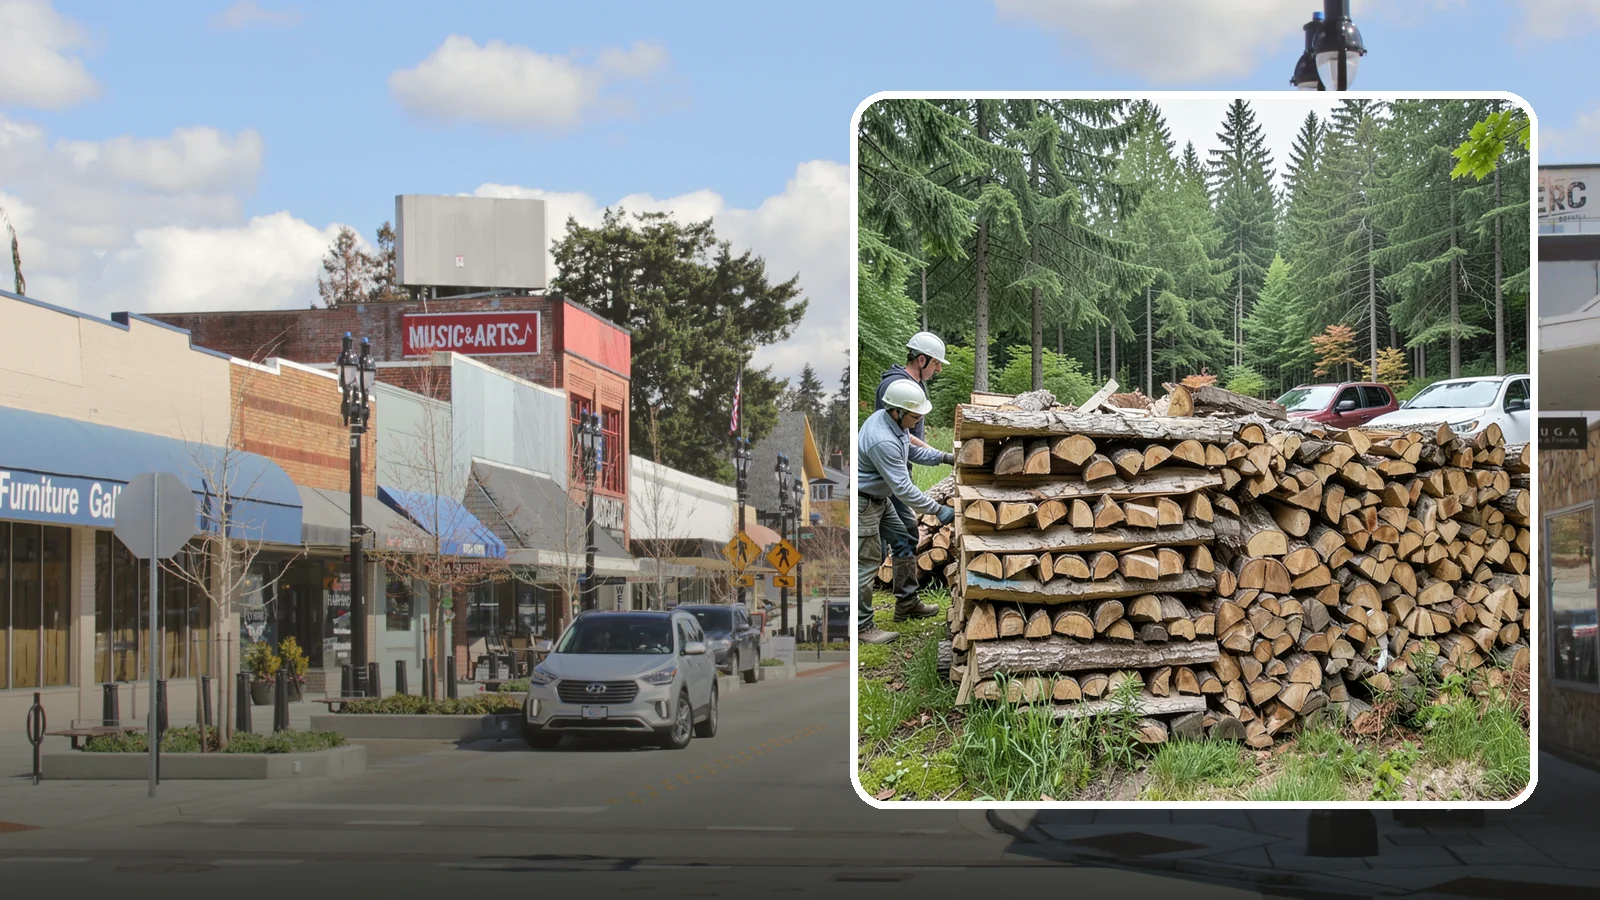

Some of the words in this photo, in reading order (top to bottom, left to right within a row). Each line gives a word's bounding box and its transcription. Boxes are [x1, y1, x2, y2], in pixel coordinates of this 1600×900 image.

[408, 323, 520, 349] MUSIC&ARTS
[0, 471, 79, 515] Furniture
[89, 482, 121, 518] Gal
[453, 563, 479, 574] SUSHI
